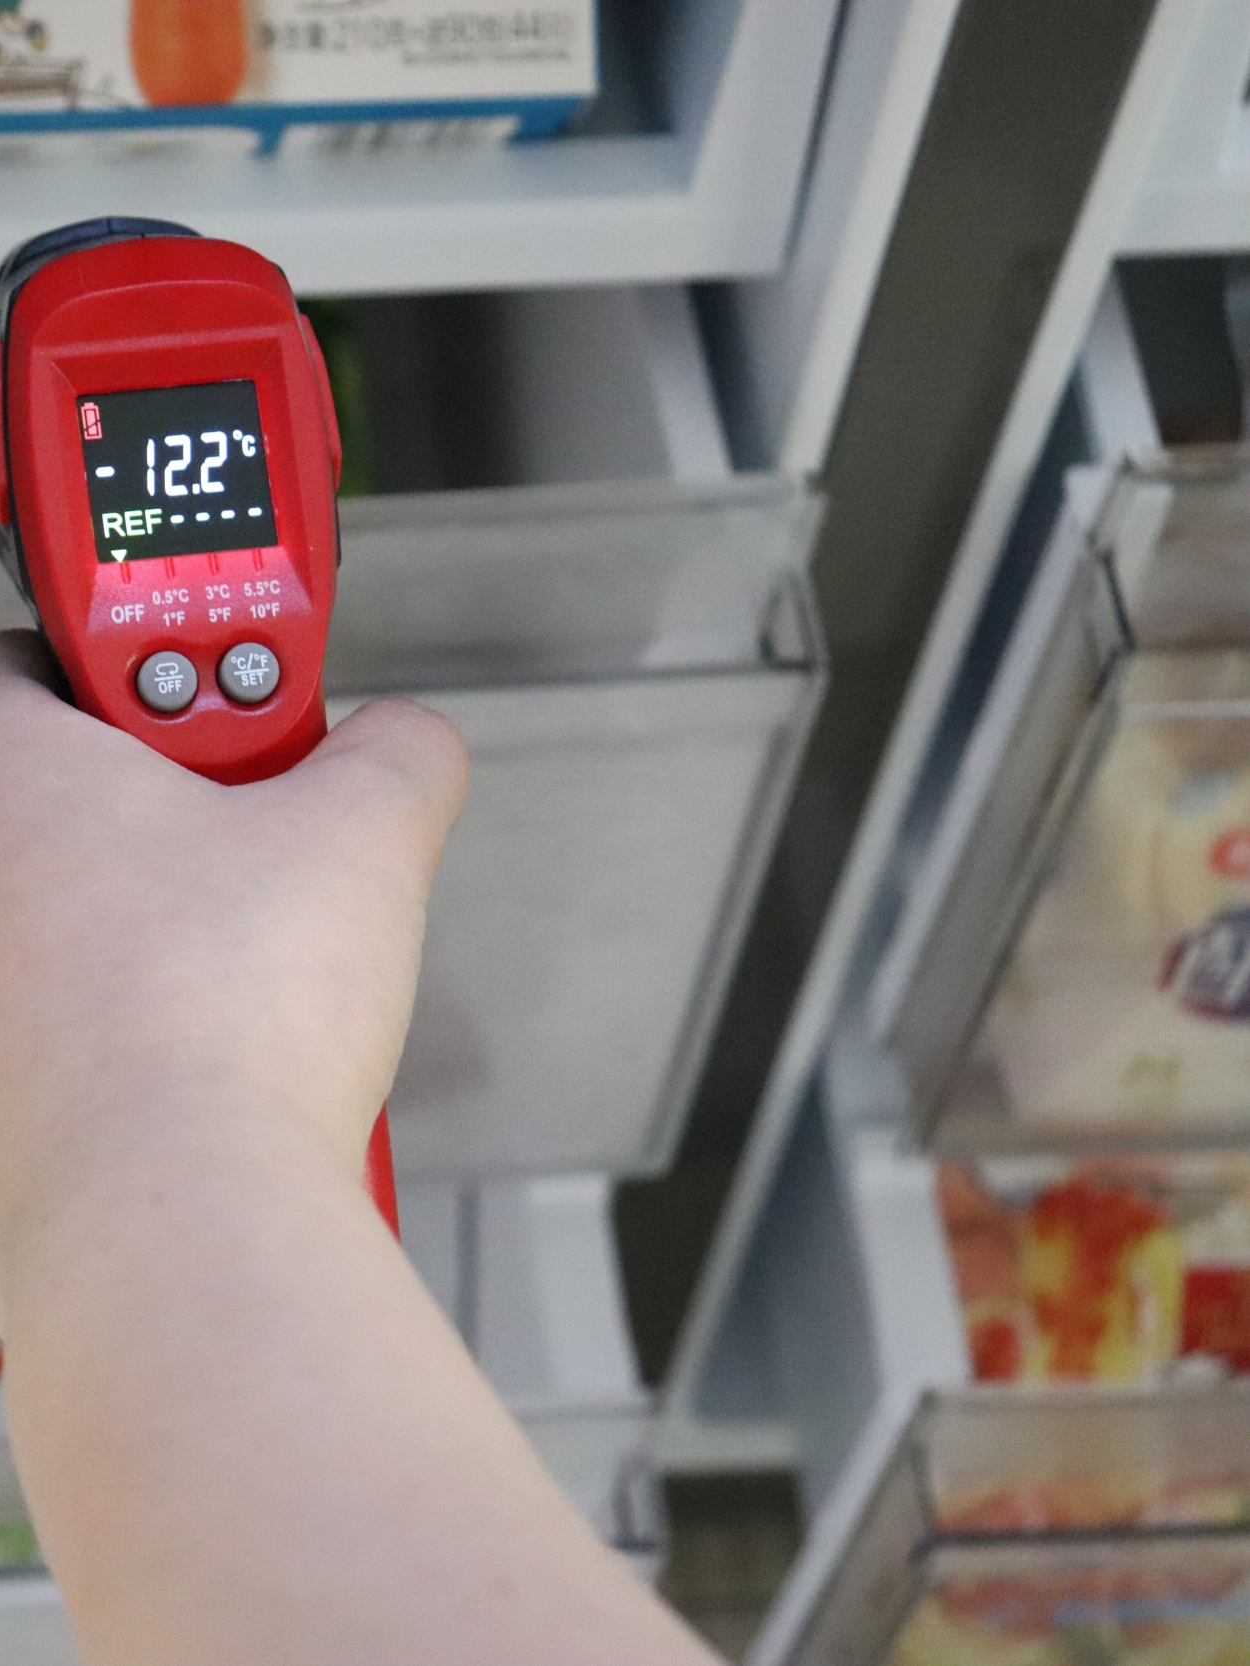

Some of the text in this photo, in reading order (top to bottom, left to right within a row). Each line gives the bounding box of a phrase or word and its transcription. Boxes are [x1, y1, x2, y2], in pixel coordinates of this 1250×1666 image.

[102, 508, 163, 538] REF
[152, 580, 281, 606] 0.5°C 3°C 5.5°C
[110, 602, 280, 626] OFF 1°F 5°F 10°F
[157, 681, 182, 694] OFF
[240, 672, 265, 686] SET
